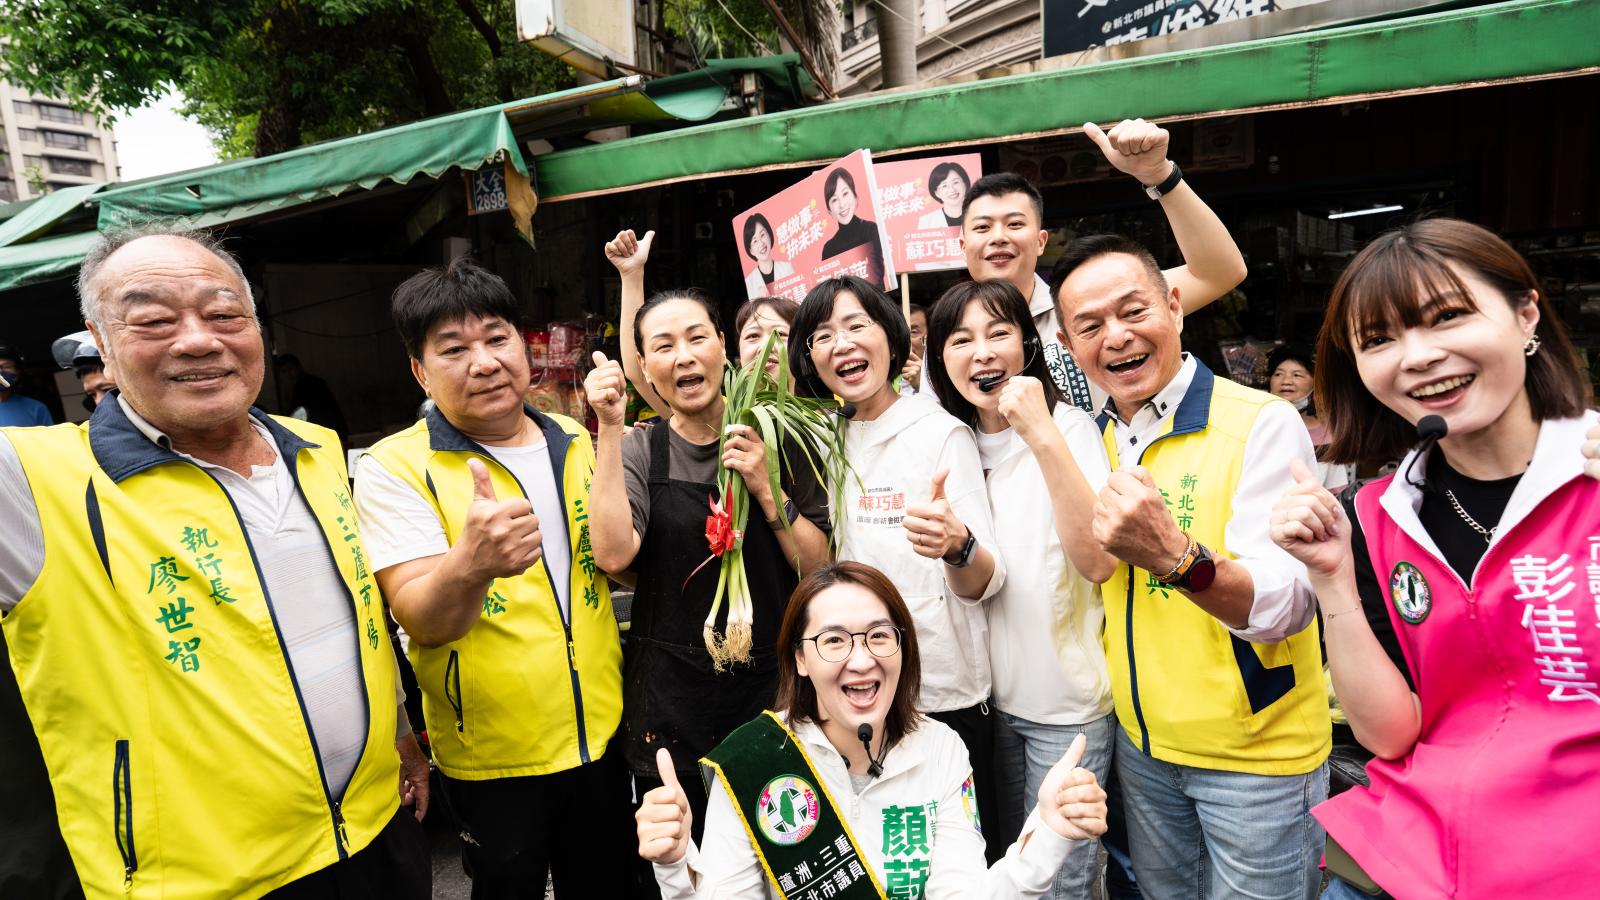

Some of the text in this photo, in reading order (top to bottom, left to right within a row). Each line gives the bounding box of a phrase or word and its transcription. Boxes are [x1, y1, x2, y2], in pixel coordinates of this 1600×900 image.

[476, 171, 504, 193] 大全
[1177, 473, 1198, 532] 新北市
[180, 526, 238, 606] 執行長
[147, 556, 202, 673] 廖世智
[1509, 554, 1600, 704] 彭佳芸
[788, 862, 866, 900] 北市議員
